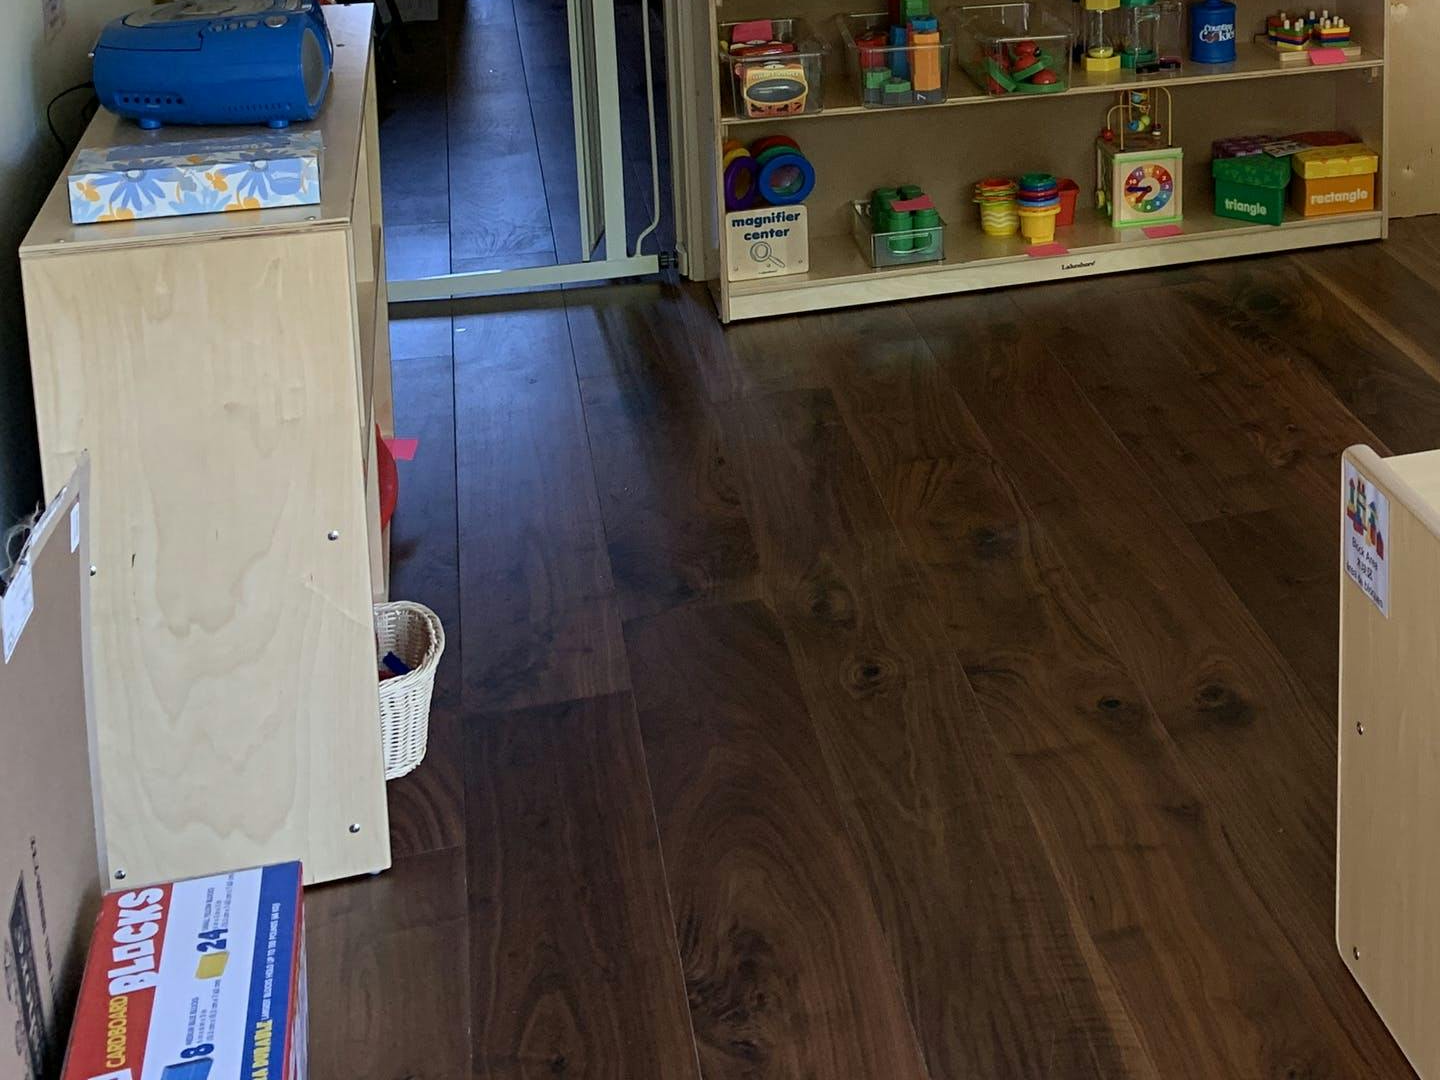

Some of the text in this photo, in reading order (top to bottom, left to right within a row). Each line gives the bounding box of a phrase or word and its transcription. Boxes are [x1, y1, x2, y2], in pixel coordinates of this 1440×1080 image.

[1311, 188, 1368, 205] rectangle
[1225, 198, 1267, 216] triangle
[731, 211, 801, 228] magnifier
[743, 228, 790, 241] center
[107, 887, 164, 996] BLOCKS
[196, 928, 228, 952] 24
[106, 996, 128, 1068] CARDBOARD
[180, 1043, 214, 1059] 8
